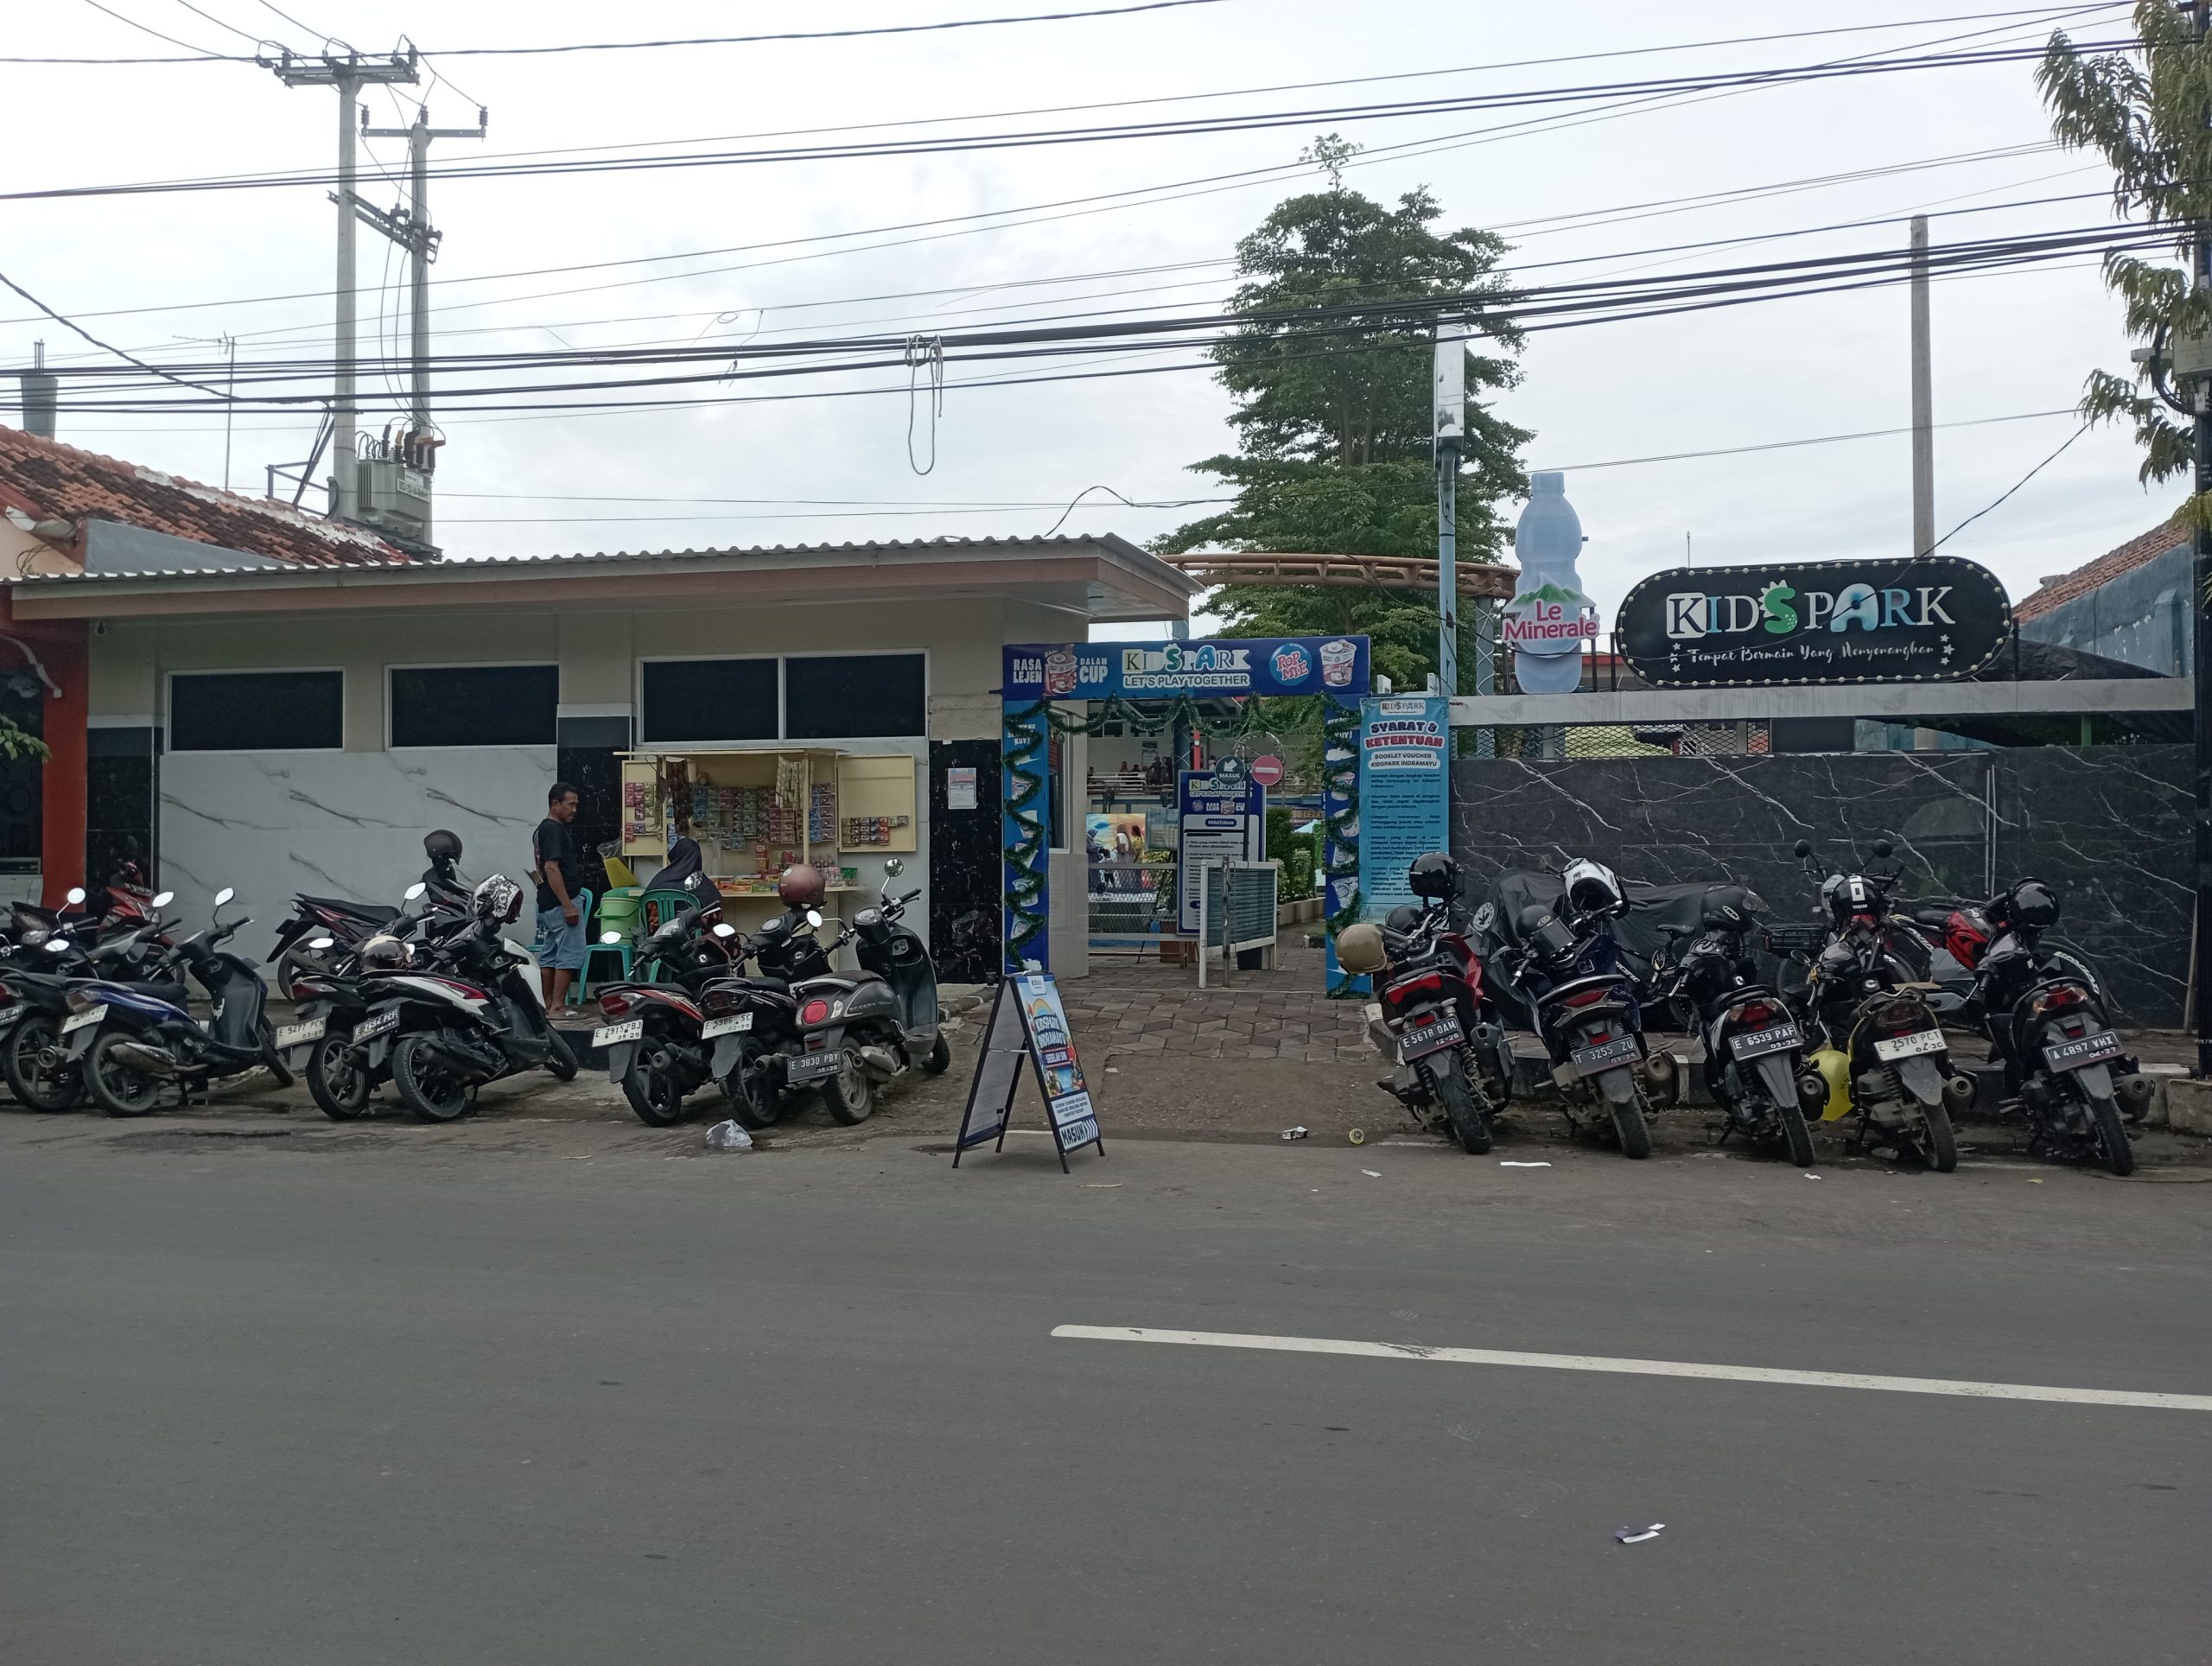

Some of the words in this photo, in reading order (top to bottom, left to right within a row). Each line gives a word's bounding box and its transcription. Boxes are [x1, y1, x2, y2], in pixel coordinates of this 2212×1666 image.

[1535, 601, 1562, 621] Le
[1504, 616, 1598, 640] Minerale
[1686, 648, 1737, 666] Tempat
[1741, 645, 1796, 662] Bermain
[1800, 644, 1834, 664] Yang
[1014, 658, 1042, 671] RASA
[1013, 671, 1042, 684] LEJEN
[1079, 665, 1109, 684] CUP
[1125, 677, 1155, 687] LET'S
[1158, 676, 1185, 686] PLAY
[1190, 675, 1249, 685] TOGETHER
[1370, 721, 1426, 734] SYARAT
[1365, 734, 1444, 748] KETENTUAN
[278, 1028, 283, 1037] E
[595, 1029, 601, 1038] E
[626, 1021, 641, 1031] PBJ
[1402, 1038, 1410, 1048] E
[1411, 1028, 1434, 1044] 5618
[1733, 1040, 1743, 1049] E
[1746, 1033, 1772, 1046] 6539
[1775, 1027, 1795, 1039] PAF
[1891, 1036, 1917, 1049] 2570
[1920, 1031, 1940, 1042] PCT
[2053, 1050, 2062, 1059] A
[2063, 1042, 2088, 1056] 4897
[2091, 1035, 2113, 1048] VHX
[791, 1060, 797, 1070] E
[800, 1056, 820, 1068] 3830
[823, 1052, 839, 1064] PBX
[1575, 1054, 1582, 1064] T
[1589, 1046, 1613, 1060] 3255
[1620, 1040, 1634, 1052] ZU
[1061, 1124, 1086, 1146] MASUK
